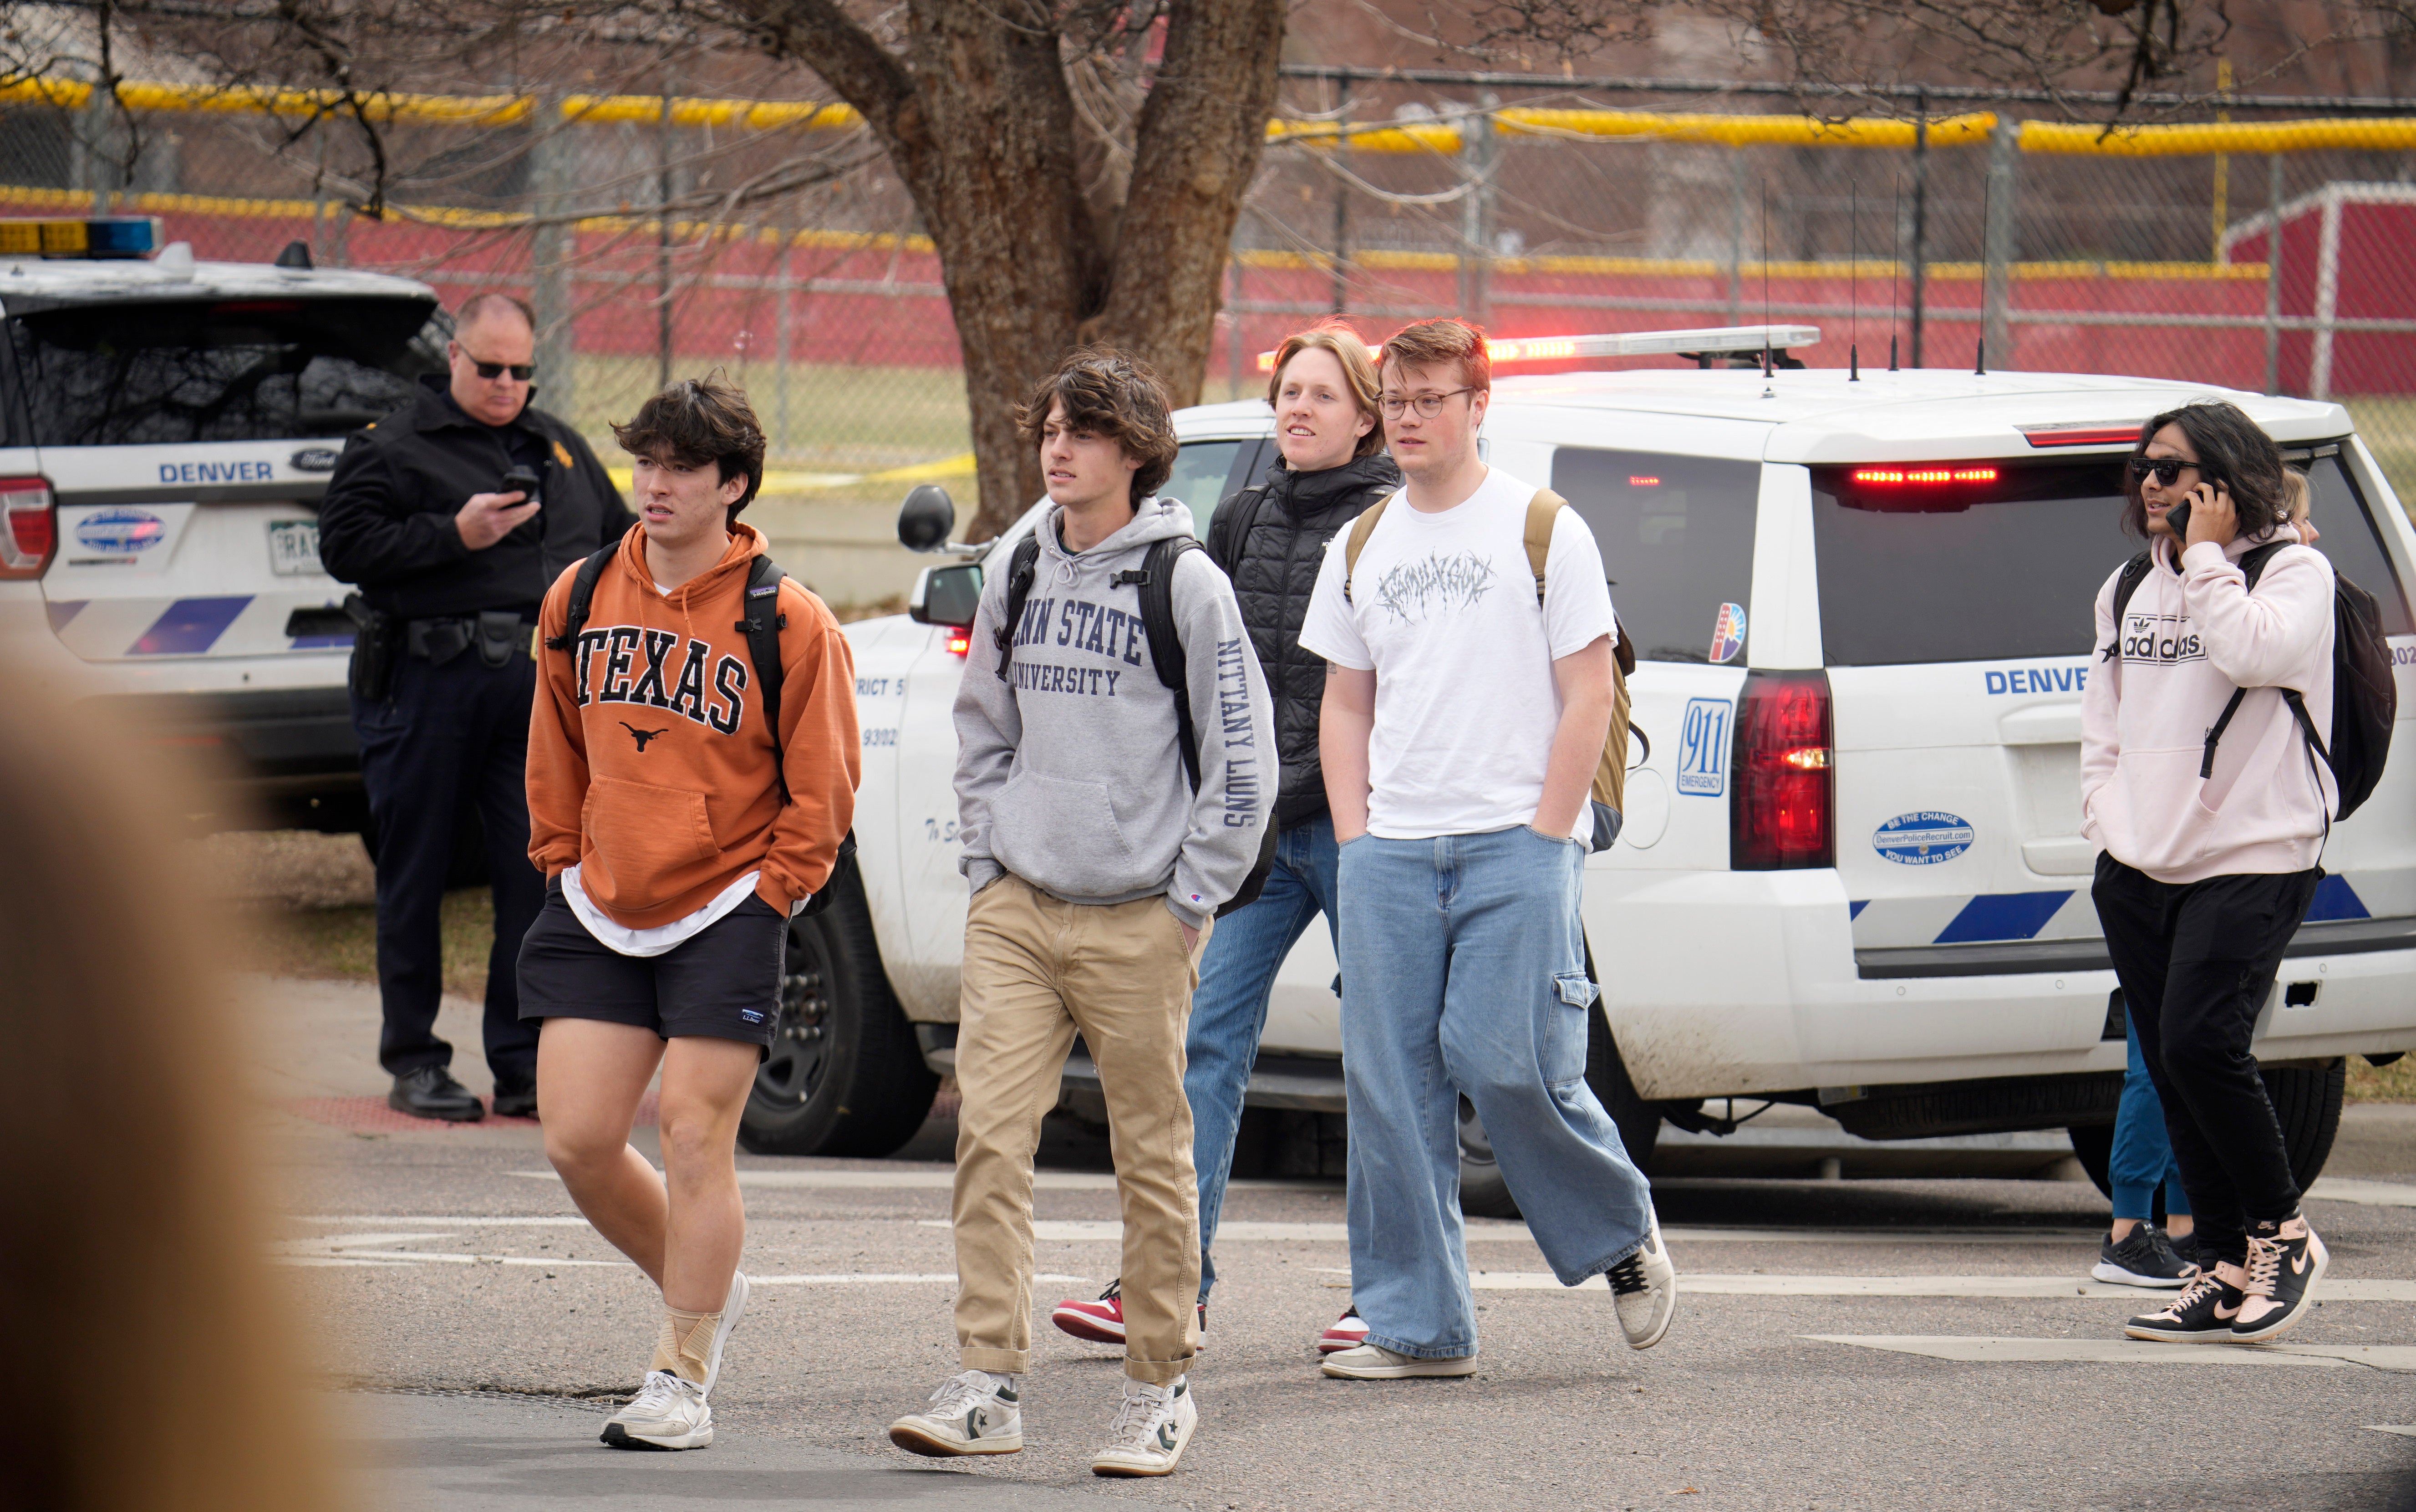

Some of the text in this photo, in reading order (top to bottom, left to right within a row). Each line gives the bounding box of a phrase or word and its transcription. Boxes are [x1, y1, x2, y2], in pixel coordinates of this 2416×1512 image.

[159, 462, 274, 483] DENVER
[1012, 598, 1144, 667] NN STATE
[576, 625, 748, 736] TEXAS
[895, 678, 904, 696] 5
[1985, 667, 2090, 695] DENVE
[863, 728, 897, 746] 9302
[1217, 637, 1261, 827] NITTANY LIONS
[1682, 706, 1725, 774] 911
[1681, 774, 1720, 789] EMERGENCY
[1887, 812, 1959, 830] BE THE CHANGE
[1876, 831, 1971, 844] DenverPoliceRecruit.com
[1885, 845, 1963, 864] YOU WANT TO SEE
